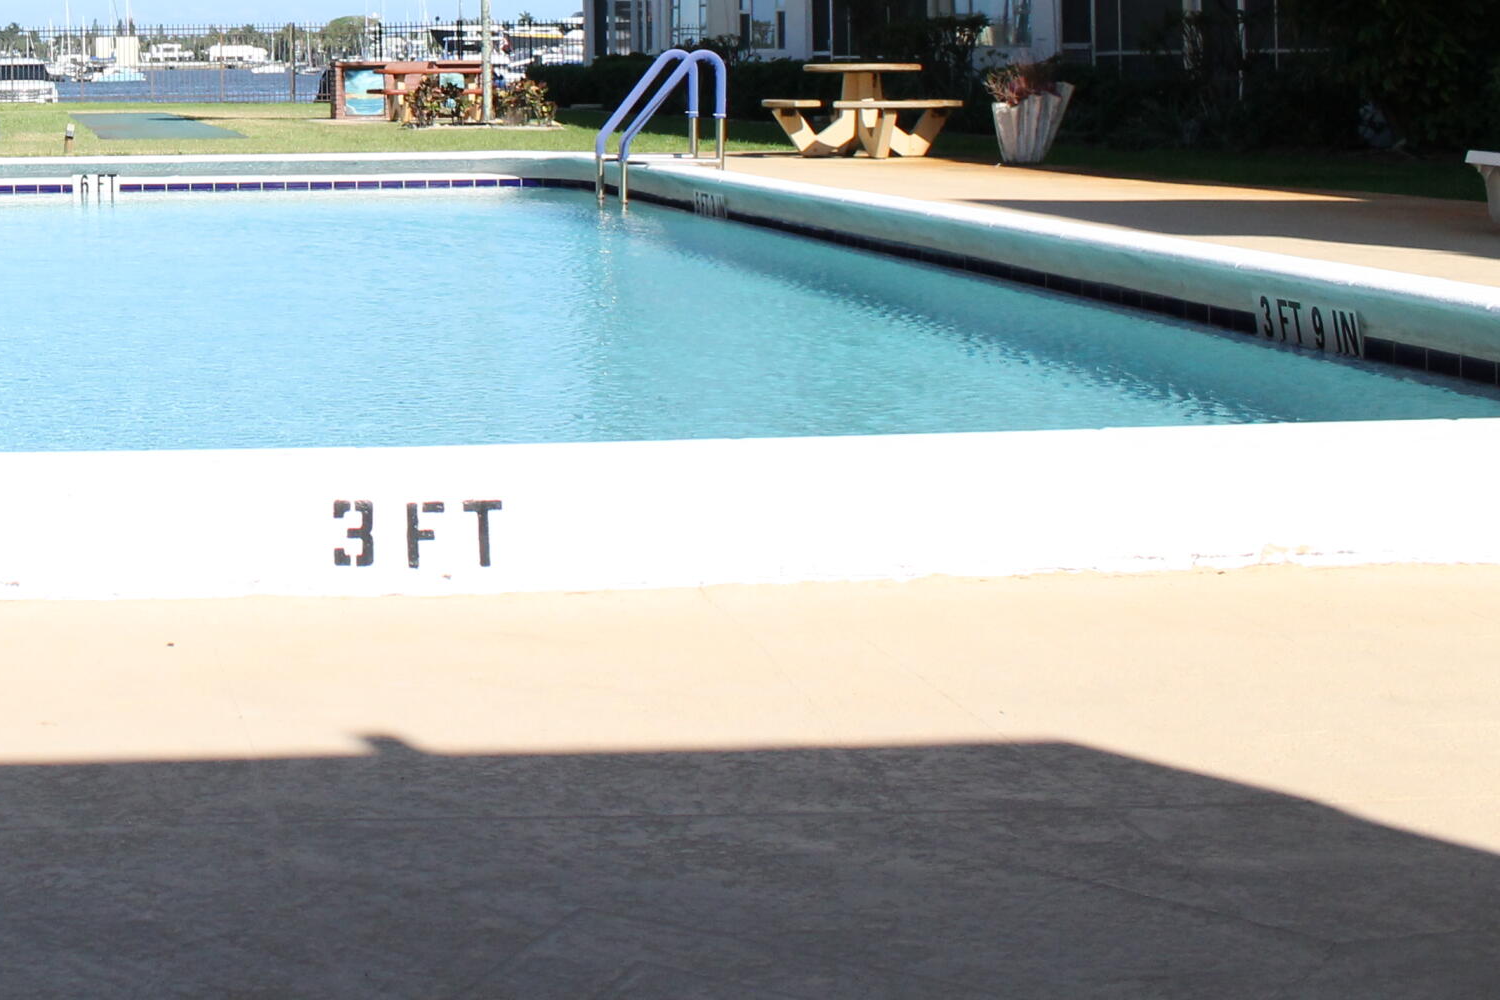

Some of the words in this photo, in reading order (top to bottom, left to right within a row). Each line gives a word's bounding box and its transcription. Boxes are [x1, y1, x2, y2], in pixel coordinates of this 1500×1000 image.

[97, 174, 117, 205] FT
[1260, 295, 1274, 338] 3
[1276, 299, 1303, 344] FT
[1311, 306, 1326, 349] 9
[1332, 309, 1360, 356] IN
[333, 500, 374, 567] 3
[407, 500, 502, 569] FT
